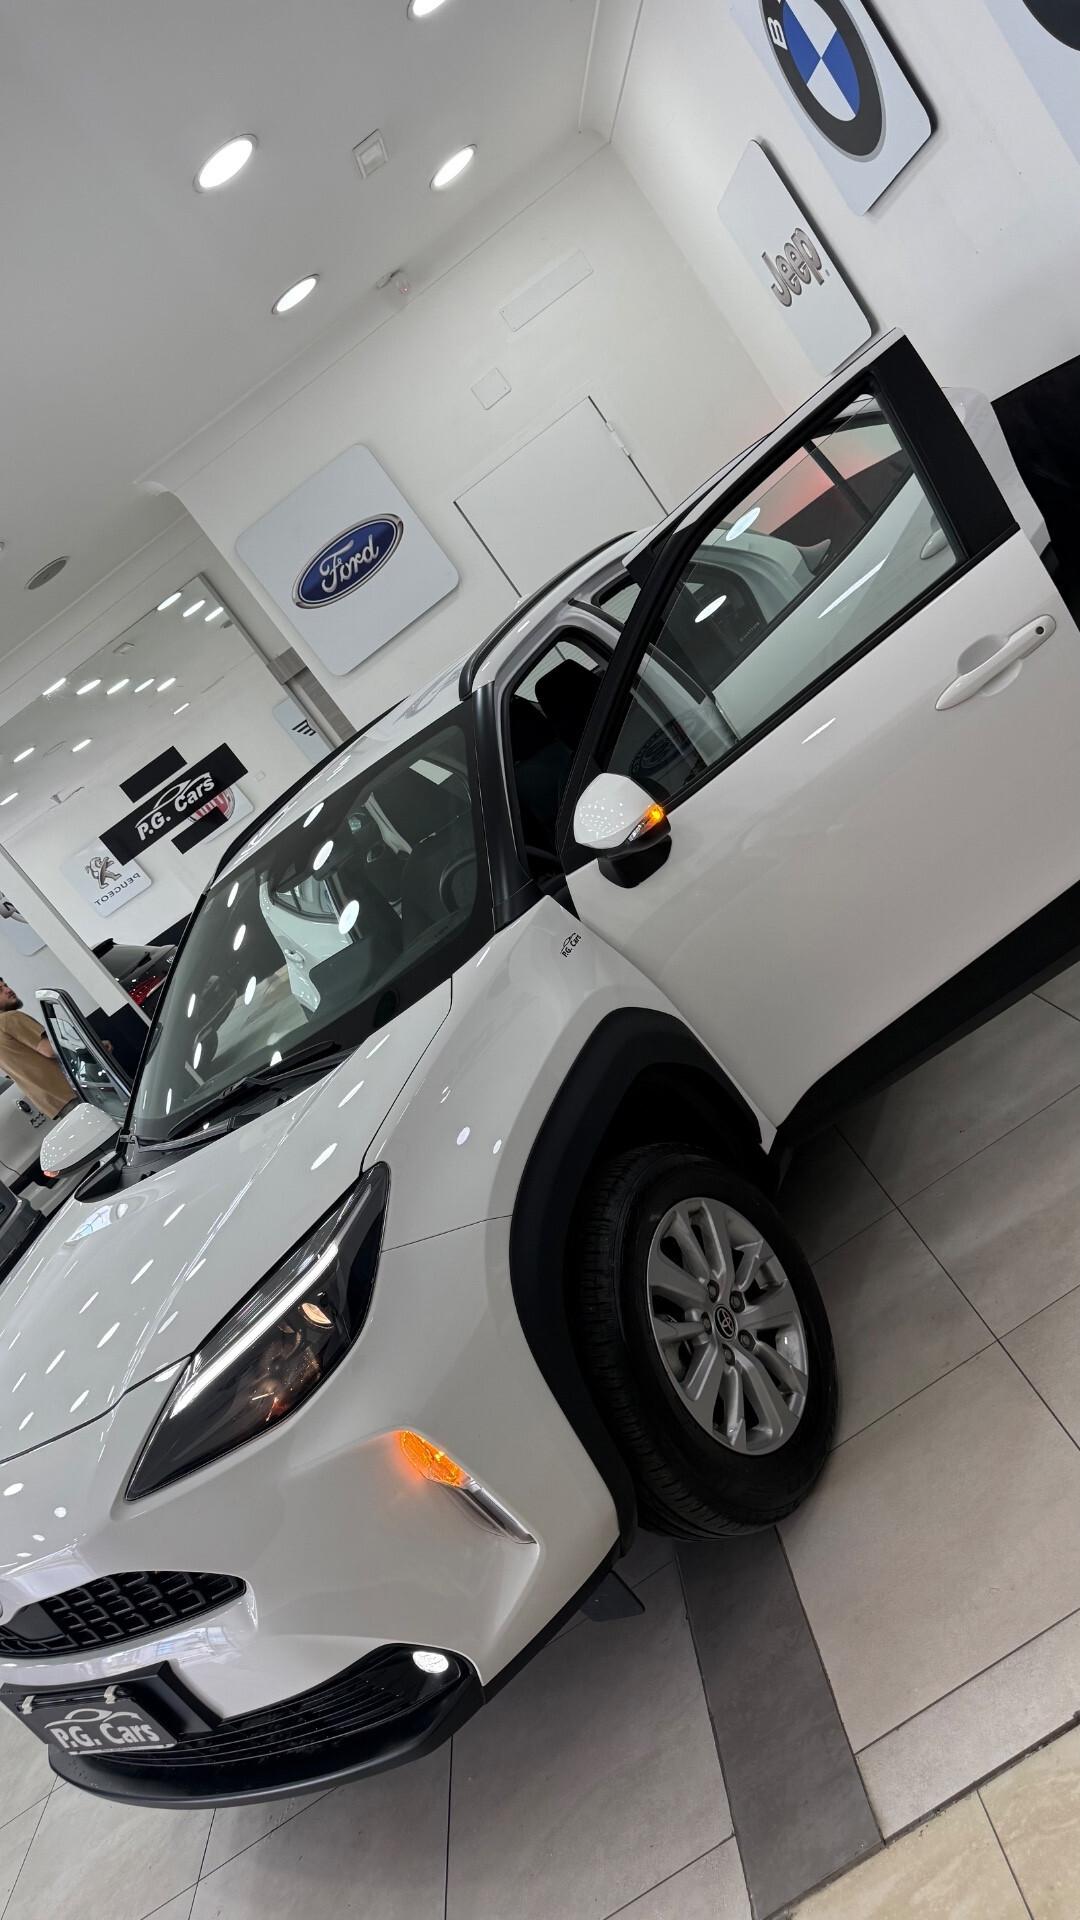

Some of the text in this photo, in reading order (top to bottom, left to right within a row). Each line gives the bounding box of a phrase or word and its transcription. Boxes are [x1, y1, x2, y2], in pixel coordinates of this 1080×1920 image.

[761, 227, 825, 308] Jeep
[319, 533, 380, 594] Ford
[136, 810, 172, 841] P.G.
[174, 777, 216, 813] Cars
[50, 1722, 161, 1749] P.G. Cars
